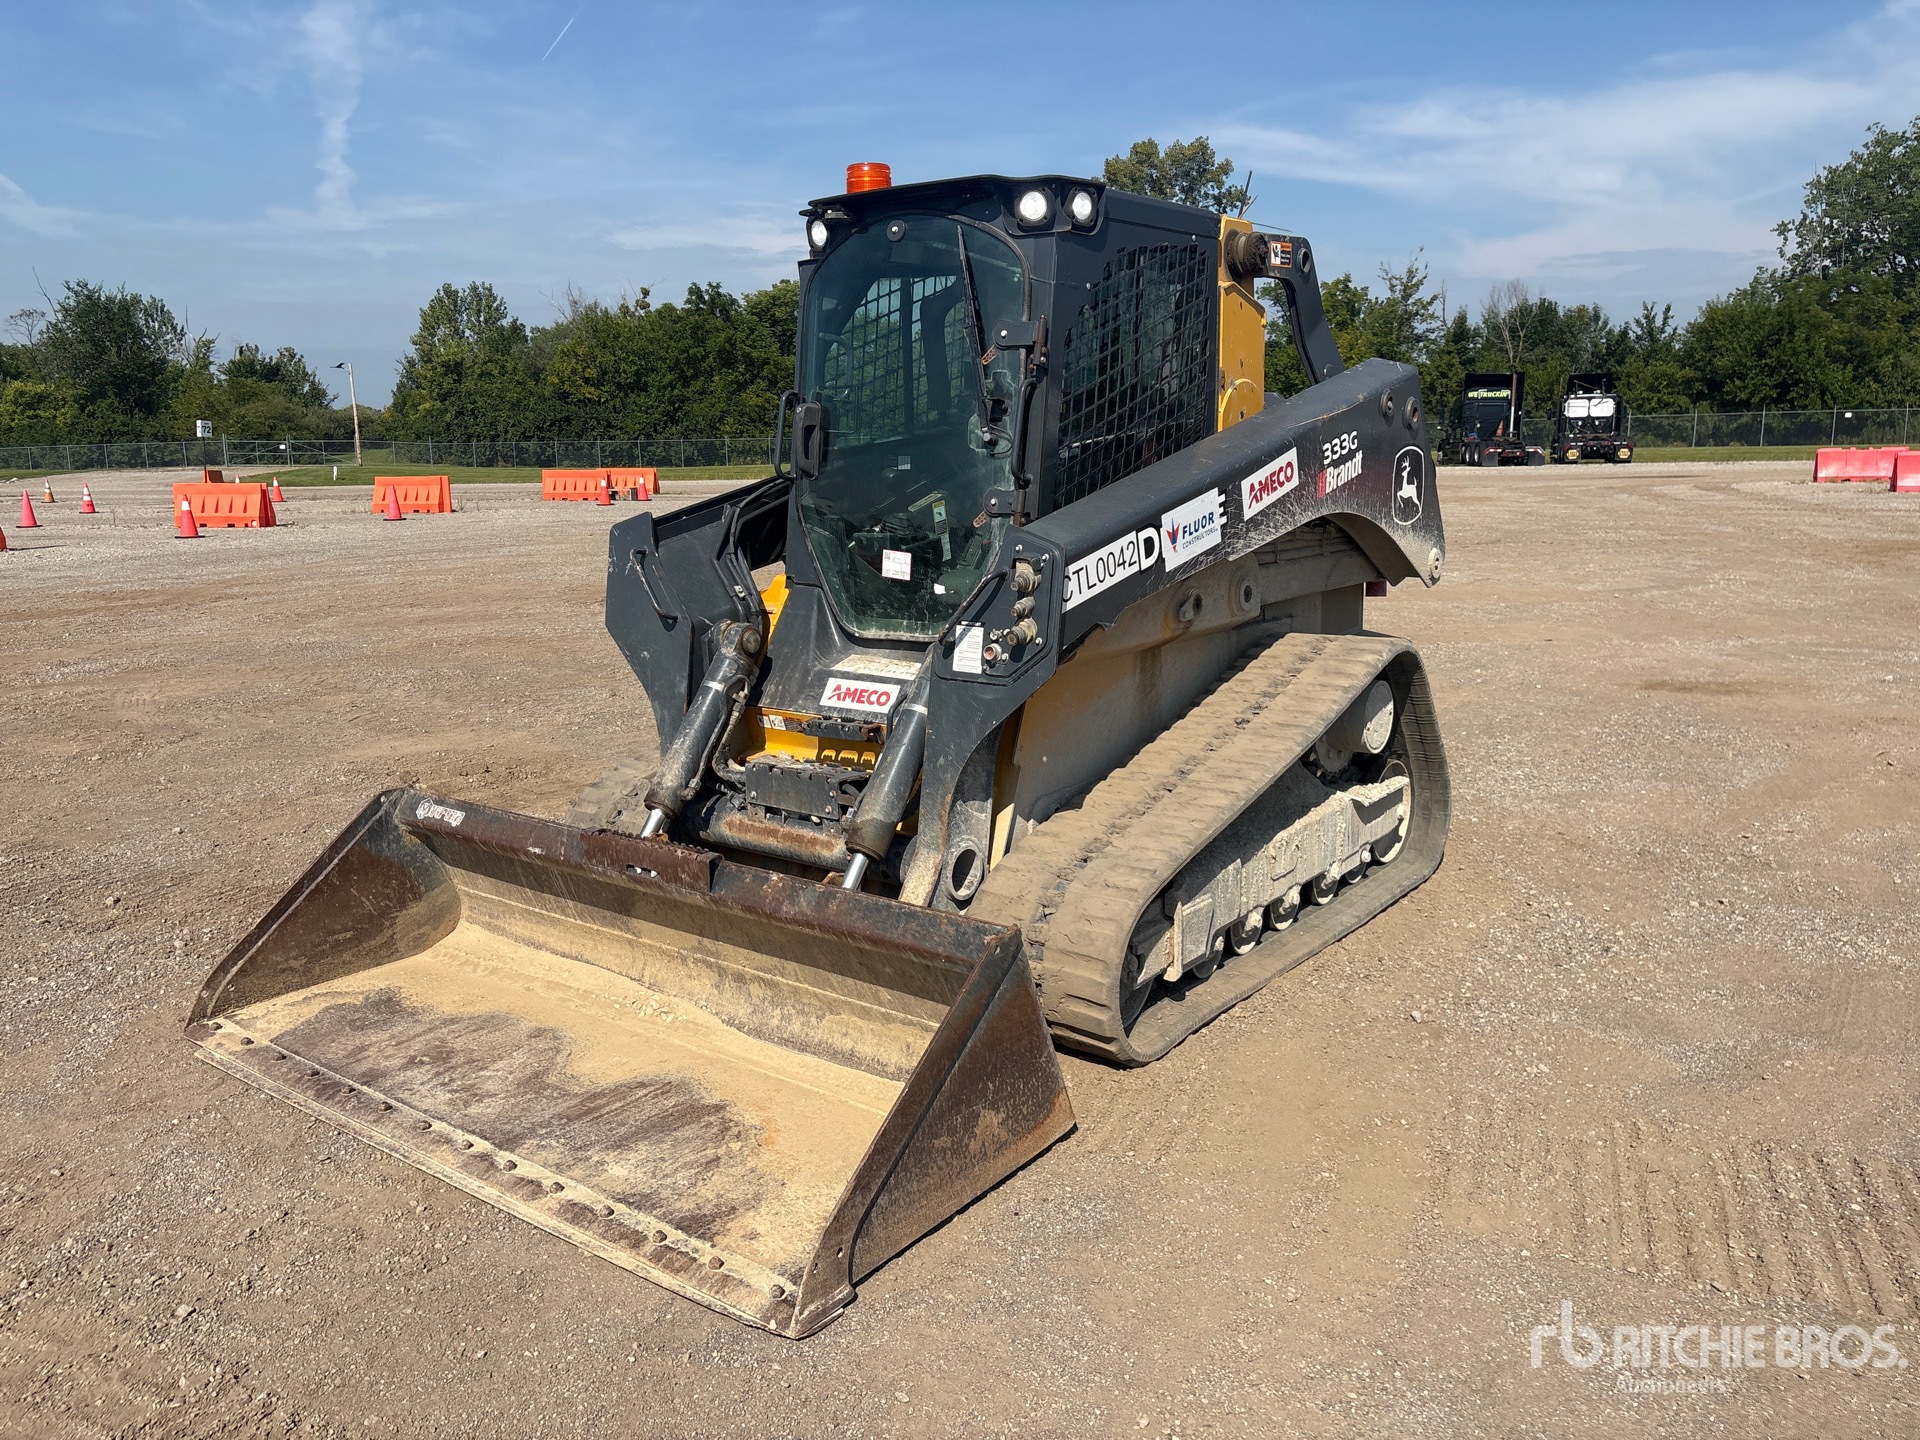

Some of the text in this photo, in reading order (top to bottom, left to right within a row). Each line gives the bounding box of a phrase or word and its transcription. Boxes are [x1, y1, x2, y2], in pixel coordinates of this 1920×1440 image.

[202, 425, 211, 434] 72
[1322, 430, 1358, 465] 333G
[1247, 461, 1295, 510] AMECO
[1325, 449, 1363, 495] Brandt
[1182, 511, 1215, 540] FLUOR
[1182, 526, 1216, 550] CONSTRUCTORS
[1062, 540, 1138, 603] CTL0042
[827, 684, 891, 707] AMECO
